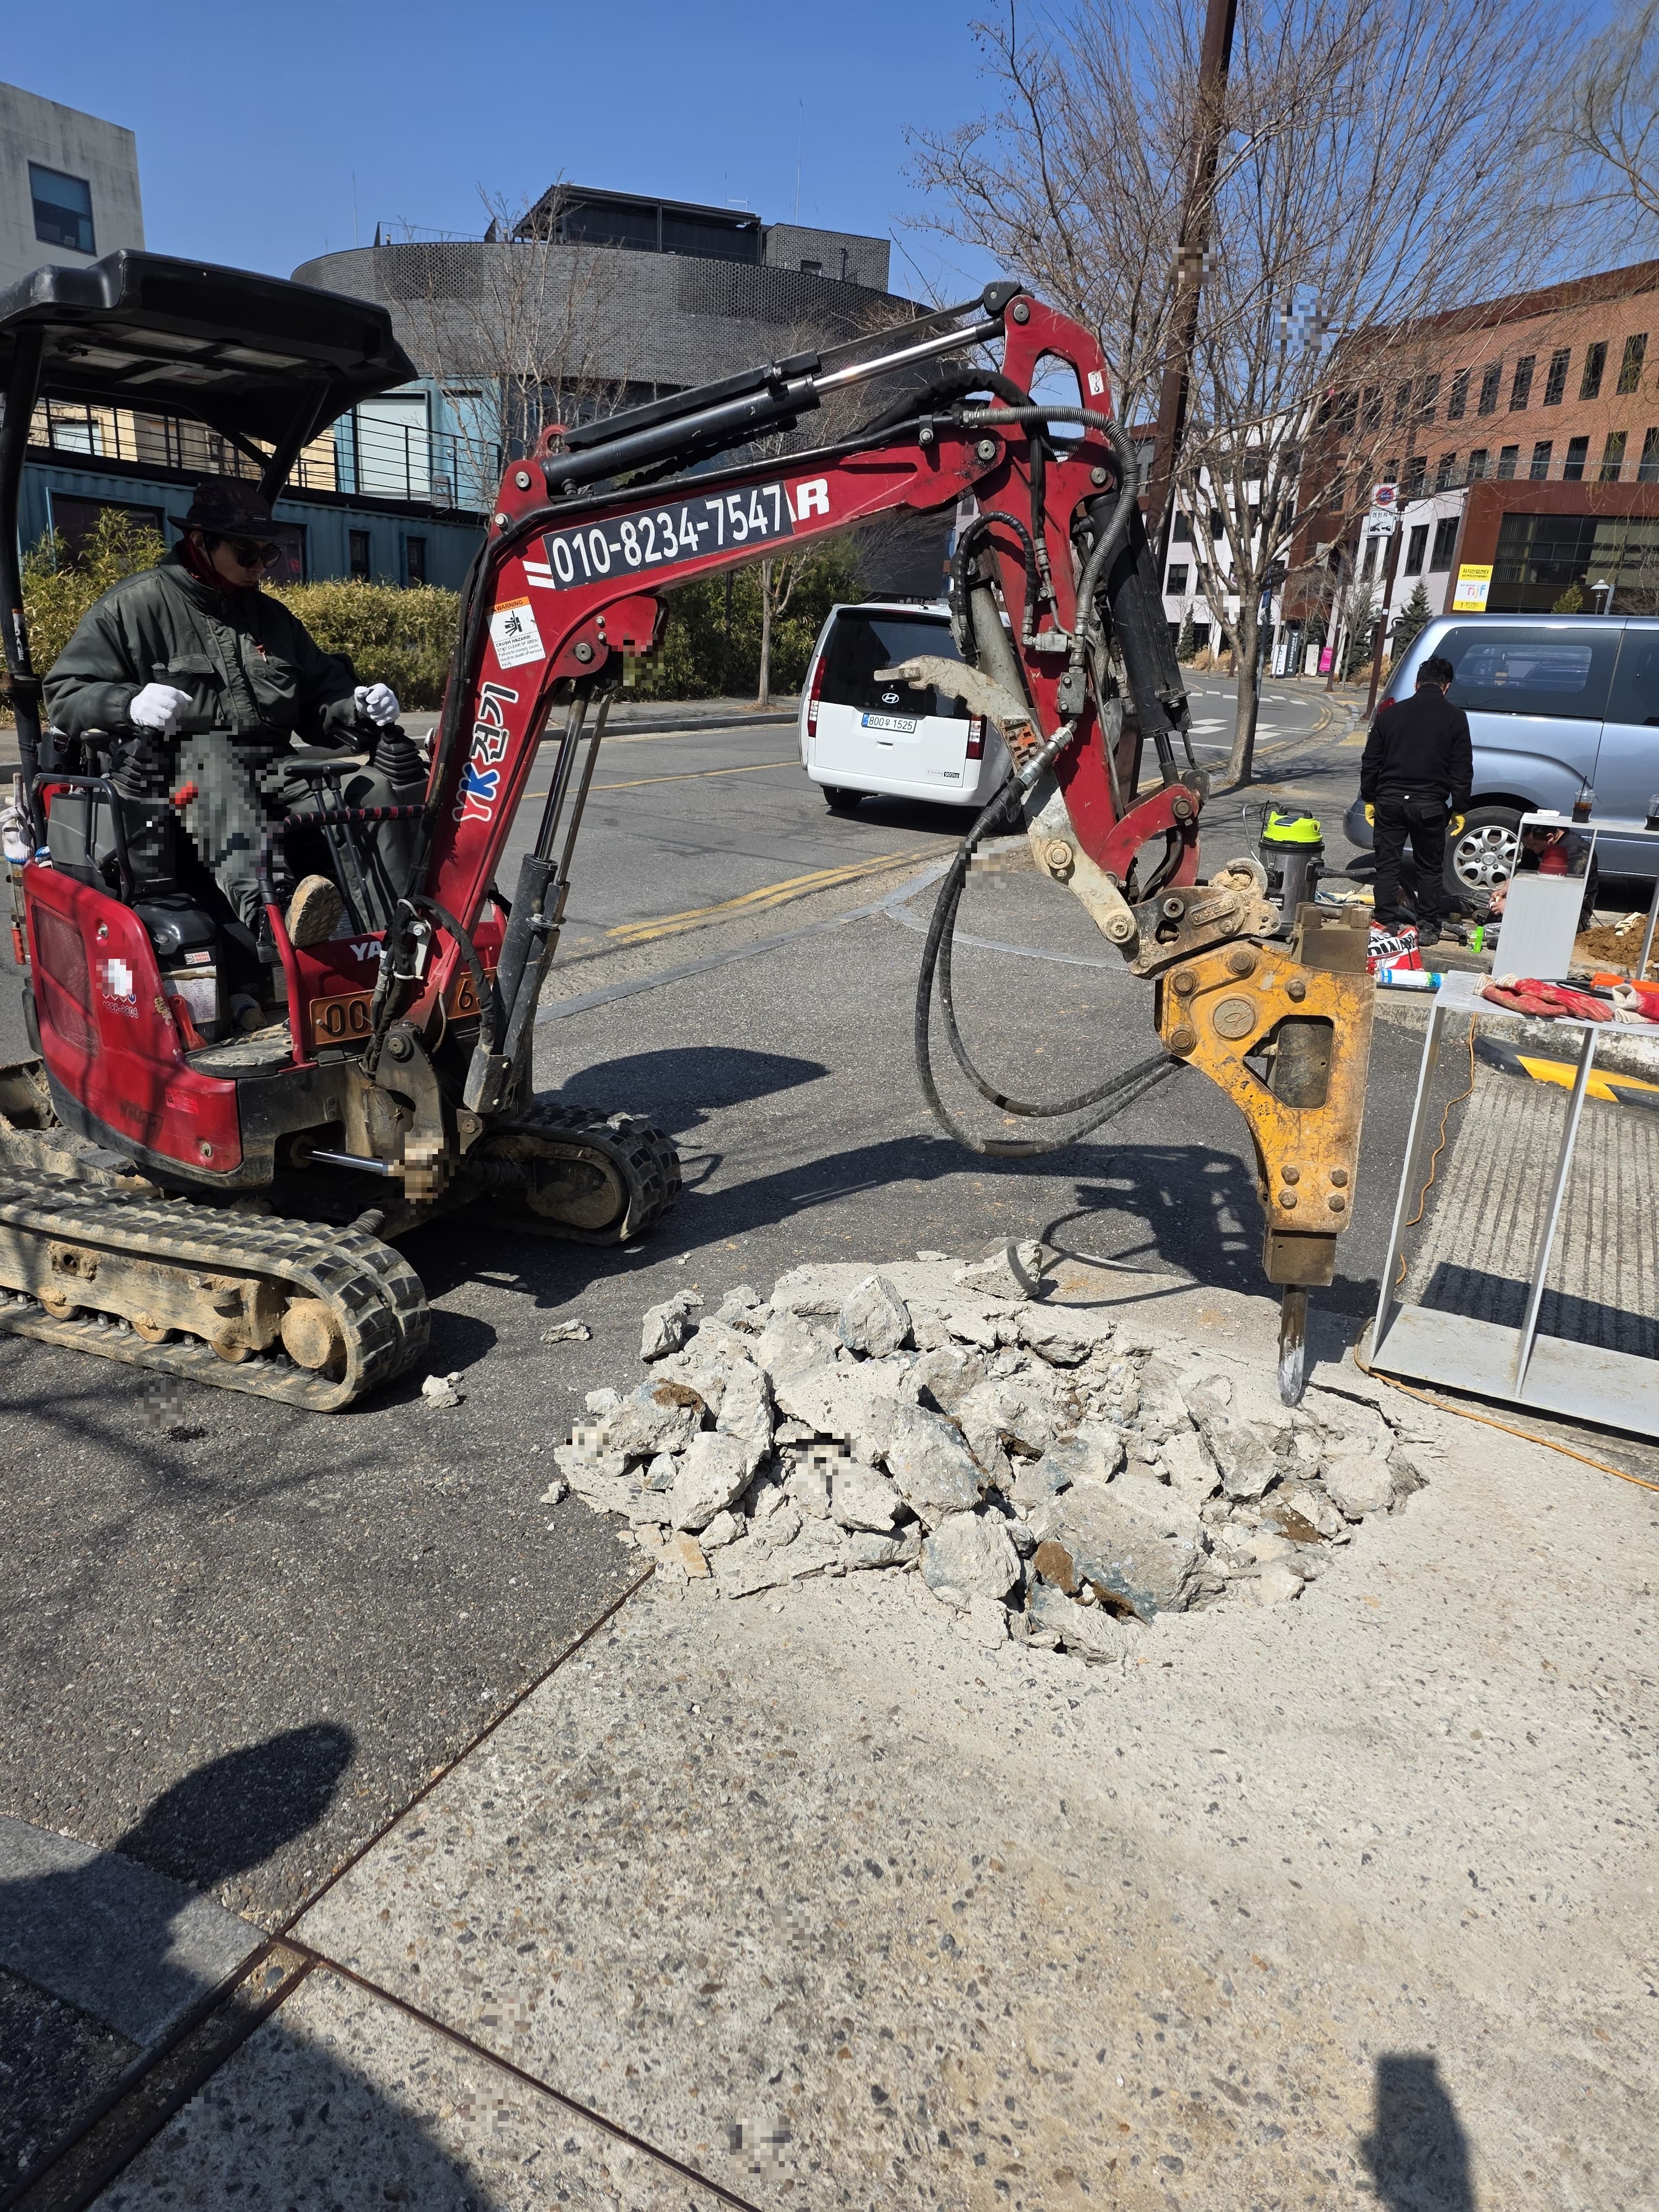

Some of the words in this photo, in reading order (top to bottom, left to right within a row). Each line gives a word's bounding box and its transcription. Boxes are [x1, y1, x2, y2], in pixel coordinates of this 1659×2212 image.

[787, 478, 830, 521] R
[552, 484, 781, 583] 010-8234-7547
[1467, 585, 1486, 598] njf
[496, 600, 523, 610] WARNING
[512, 635, 531, 644] HAZARD!
[869, 716, 891, 727] 800우
[893, 719, 913, 730] 1525
[349, 940, 382, 961] YA
[325, 998, 373, 1037] 00
[458, 978, 481, 1010] 6
